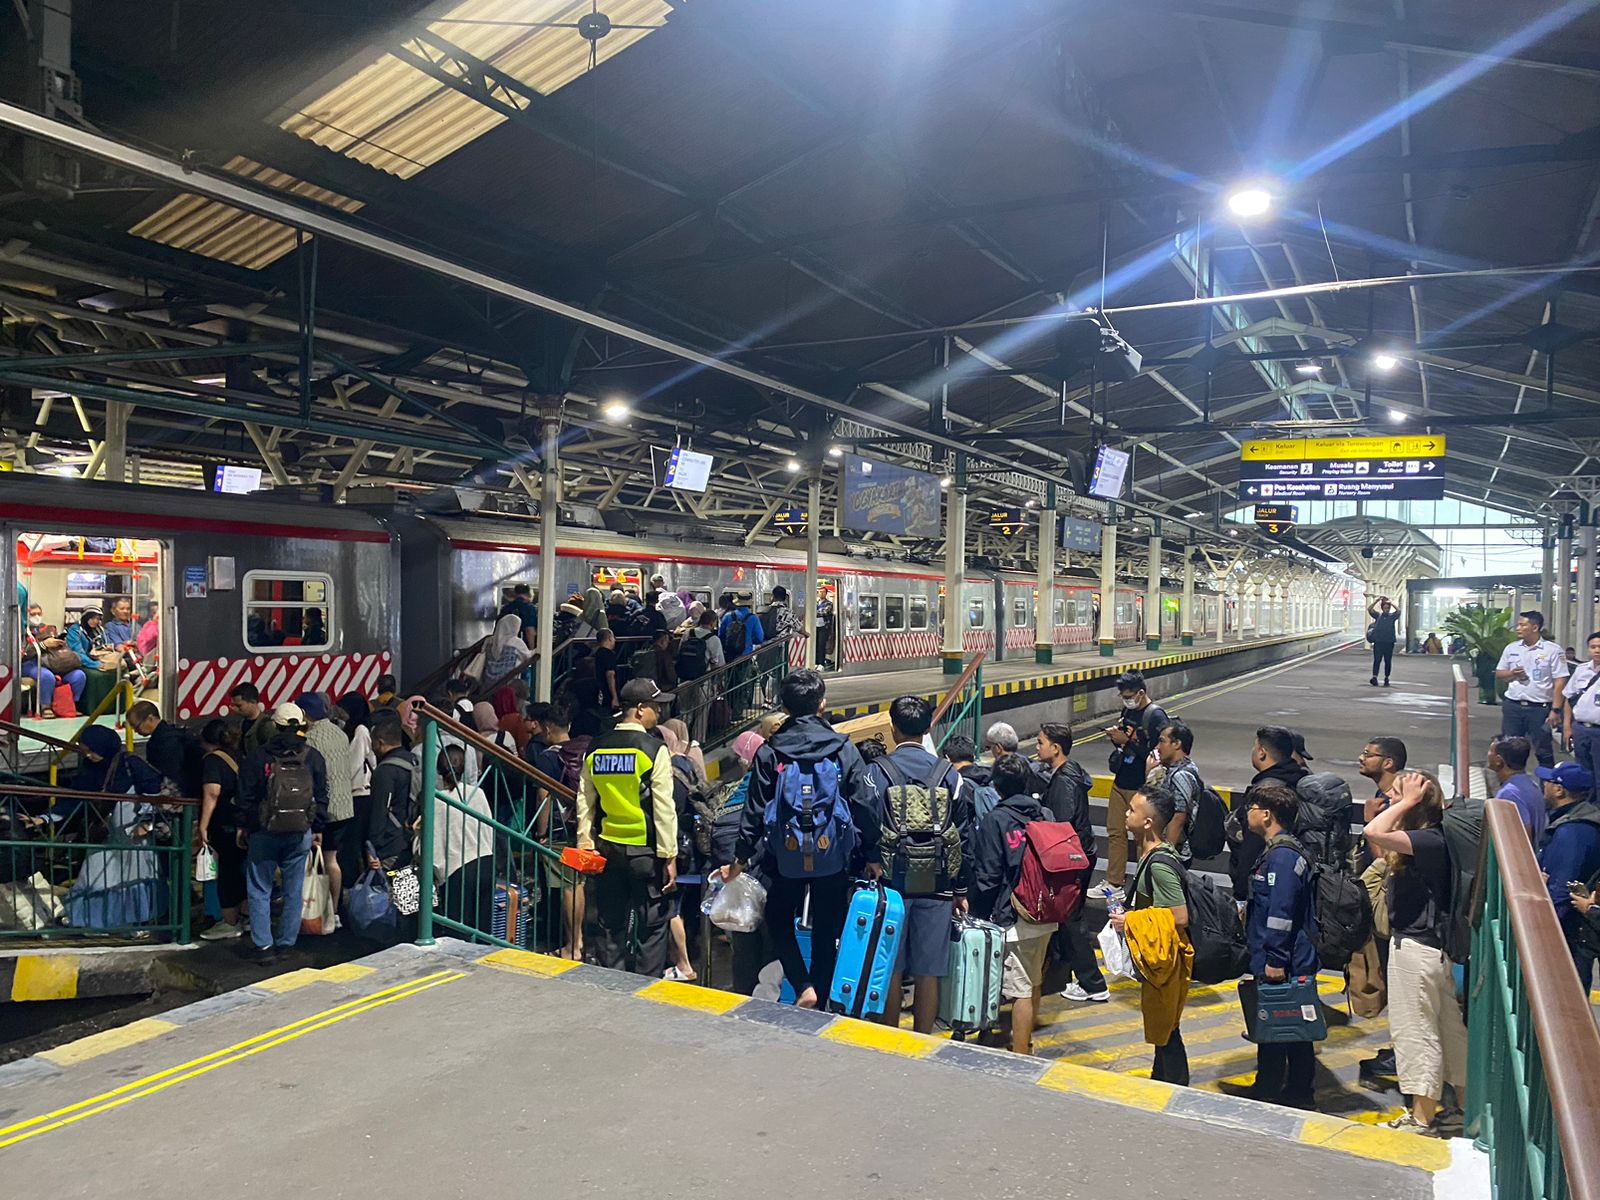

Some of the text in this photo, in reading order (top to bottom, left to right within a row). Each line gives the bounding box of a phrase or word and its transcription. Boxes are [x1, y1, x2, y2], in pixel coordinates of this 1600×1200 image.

[668, 465, 676, 474] 2
[1094, 467, 1100, 478] 3
[1360, 483, 1394, 491] Menyusui
[1002, 526, 1012, 535] 2
[1269, 524, 1279, 534] 3
[594, 755, 634, 772] SATPAM
